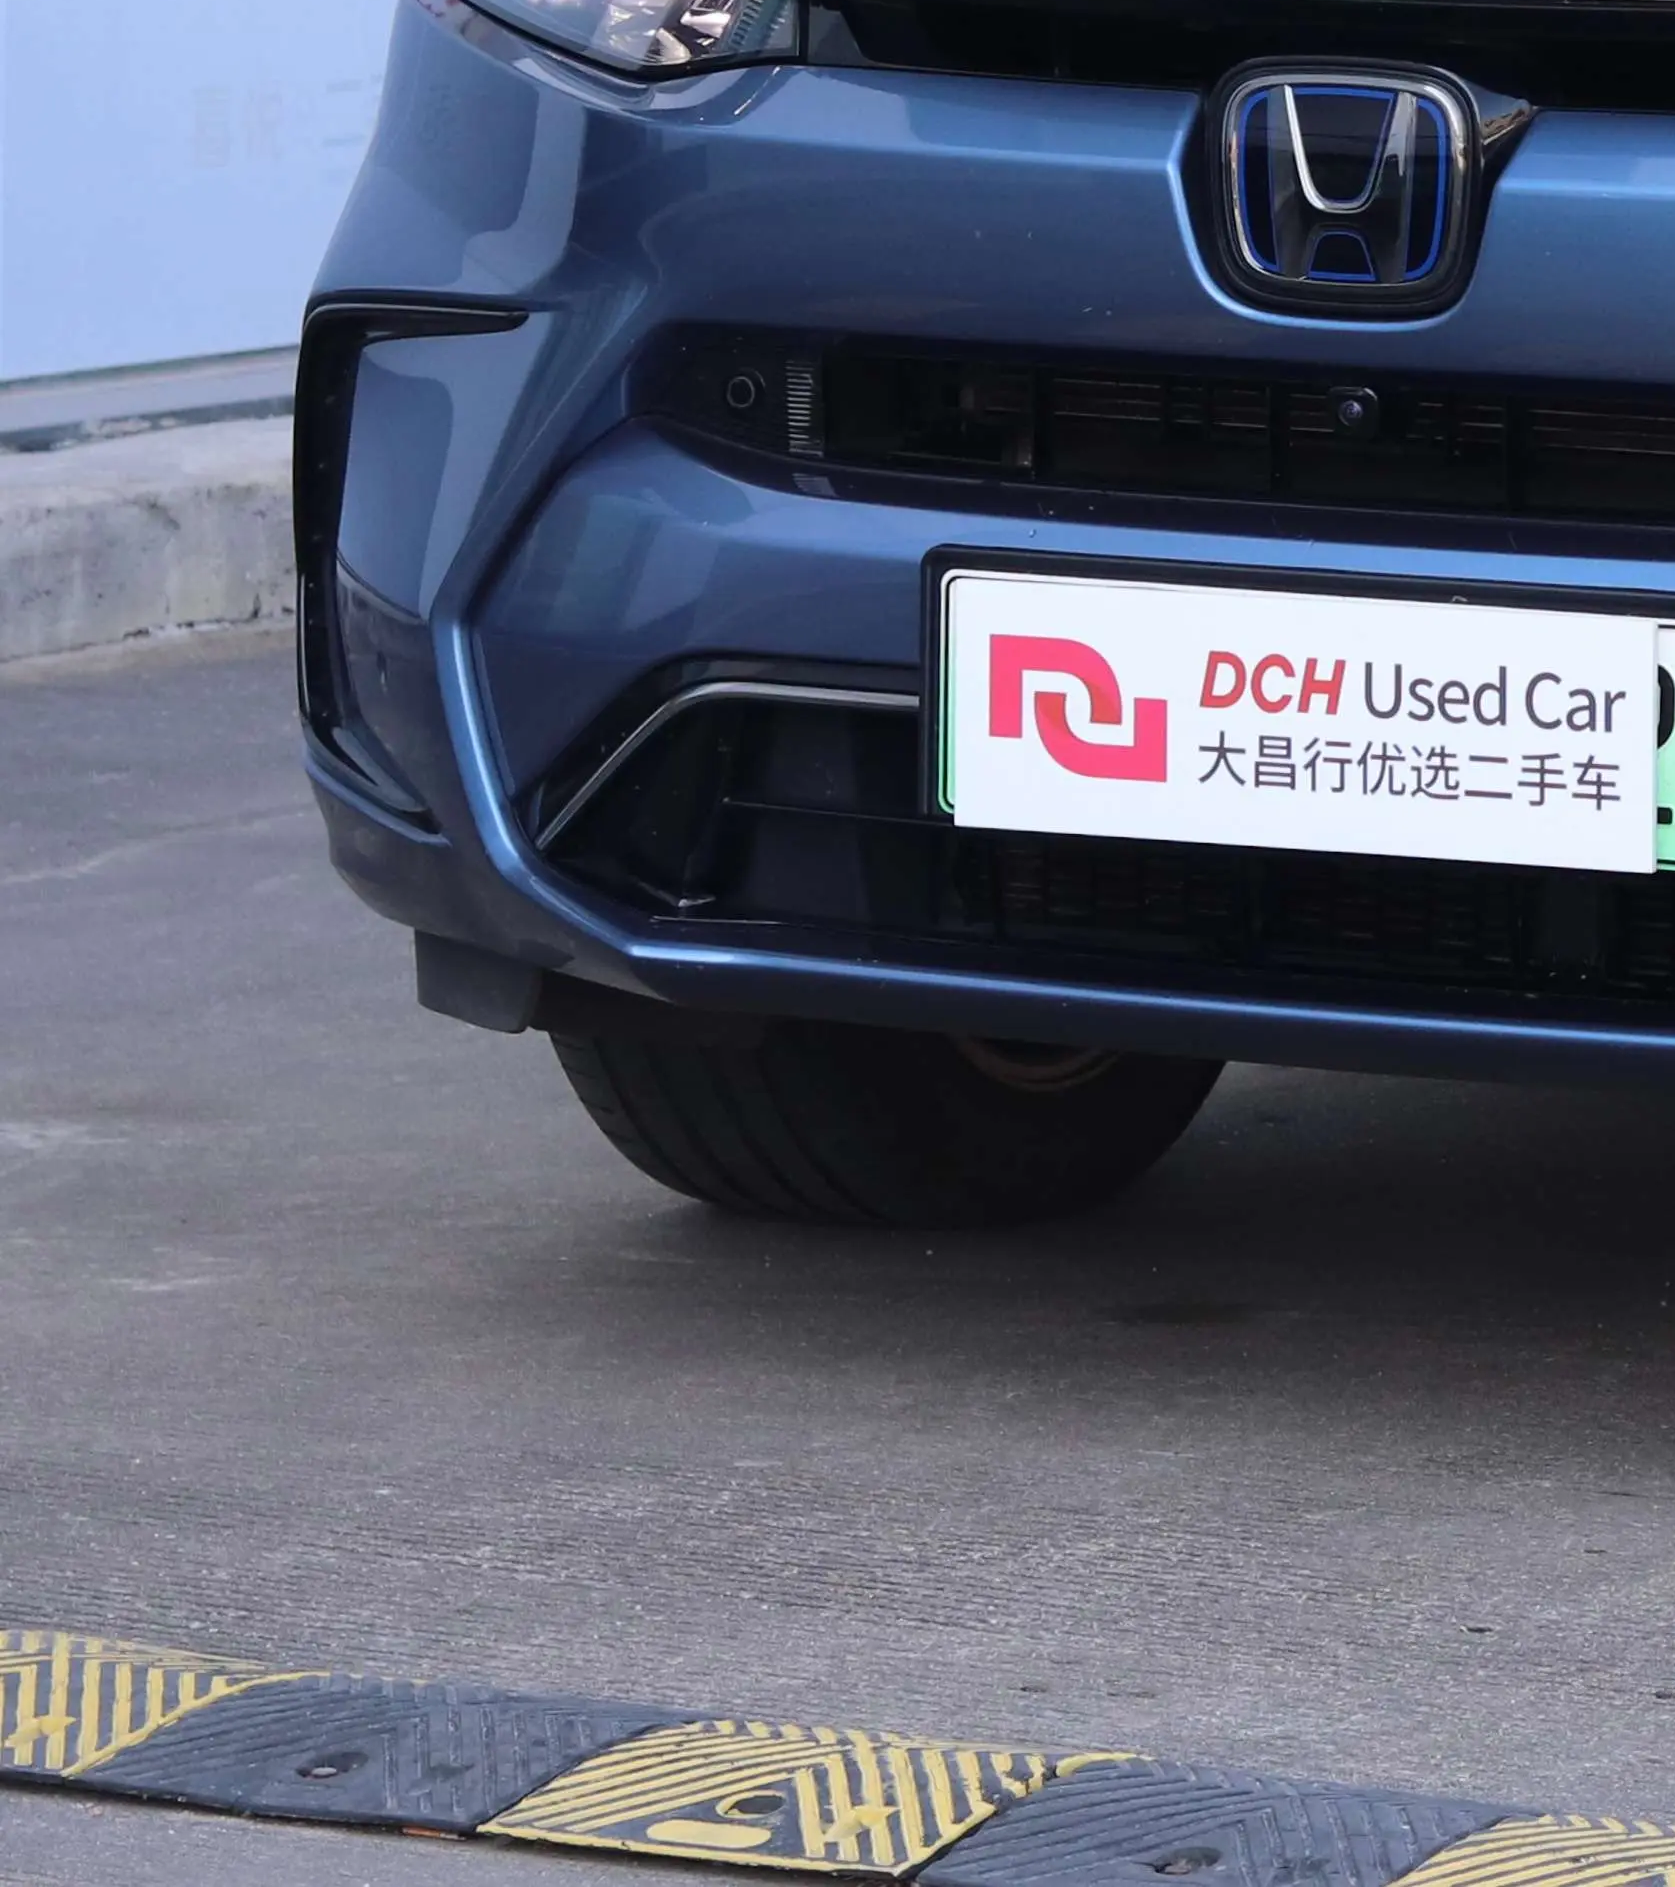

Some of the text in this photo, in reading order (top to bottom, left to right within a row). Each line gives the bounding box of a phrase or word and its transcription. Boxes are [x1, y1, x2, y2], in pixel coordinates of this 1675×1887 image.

[1199, 650, 1346, 716] DCH
[1364, 662, 1507, 732] Used
[1525, 673, 1628, 733] Car
[1198, 729, 1622, 812] 大昌行优选二手车
